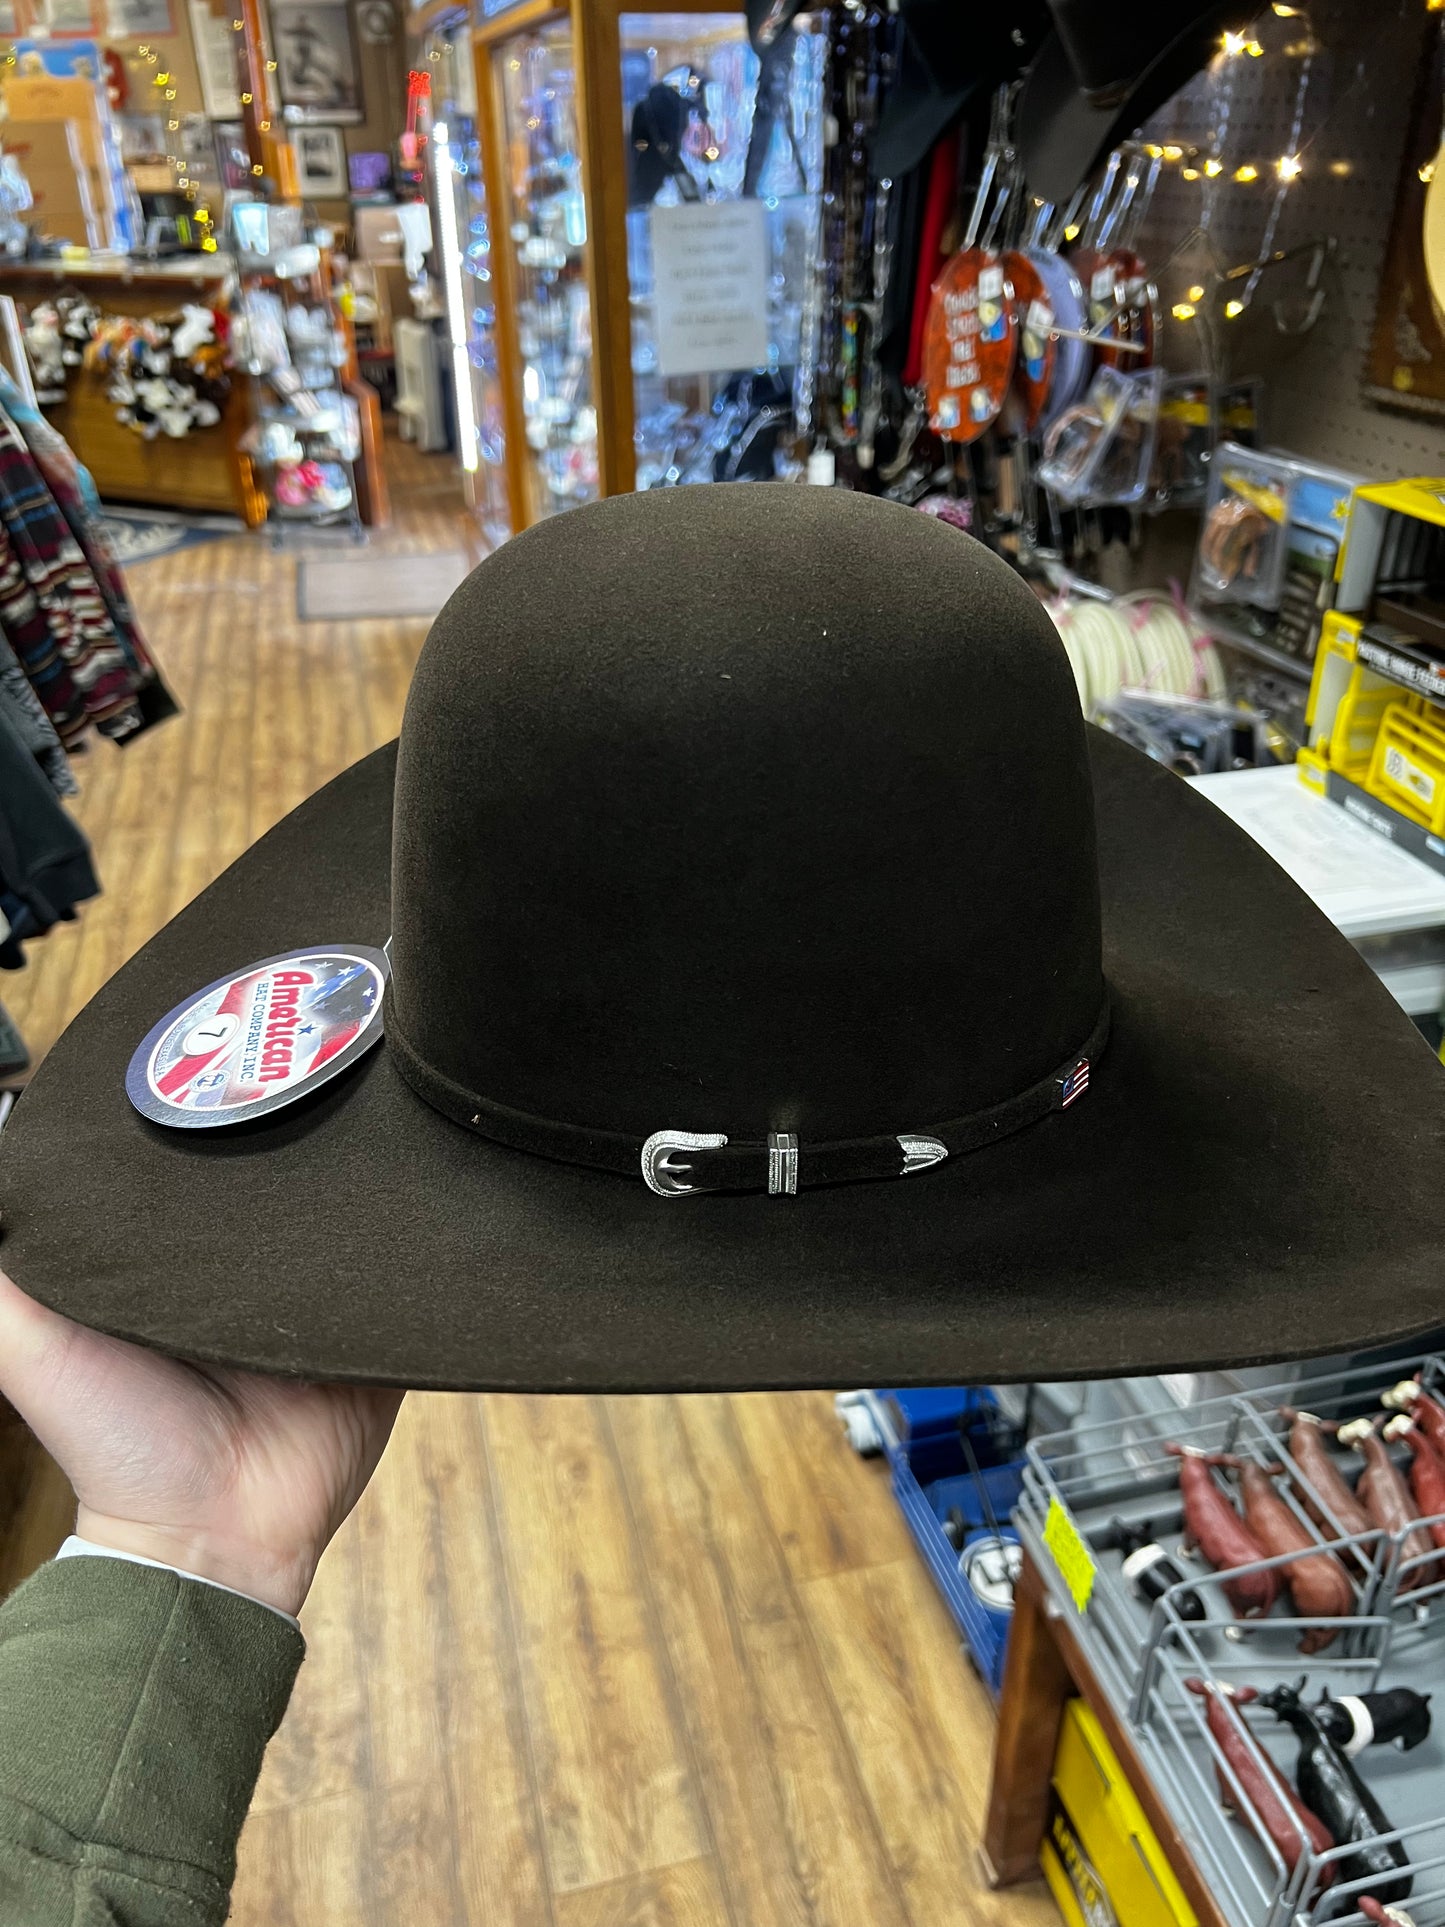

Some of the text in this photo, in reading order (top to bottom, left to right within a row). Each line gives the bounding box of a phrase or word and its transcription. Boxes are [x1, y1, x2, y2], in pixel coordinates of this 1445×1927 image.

[198, 1026, 229, 1038] 7
[239, 982, 269, 1083] HAT COMPANY, INC.
[258, 970, 314, 1083] American
